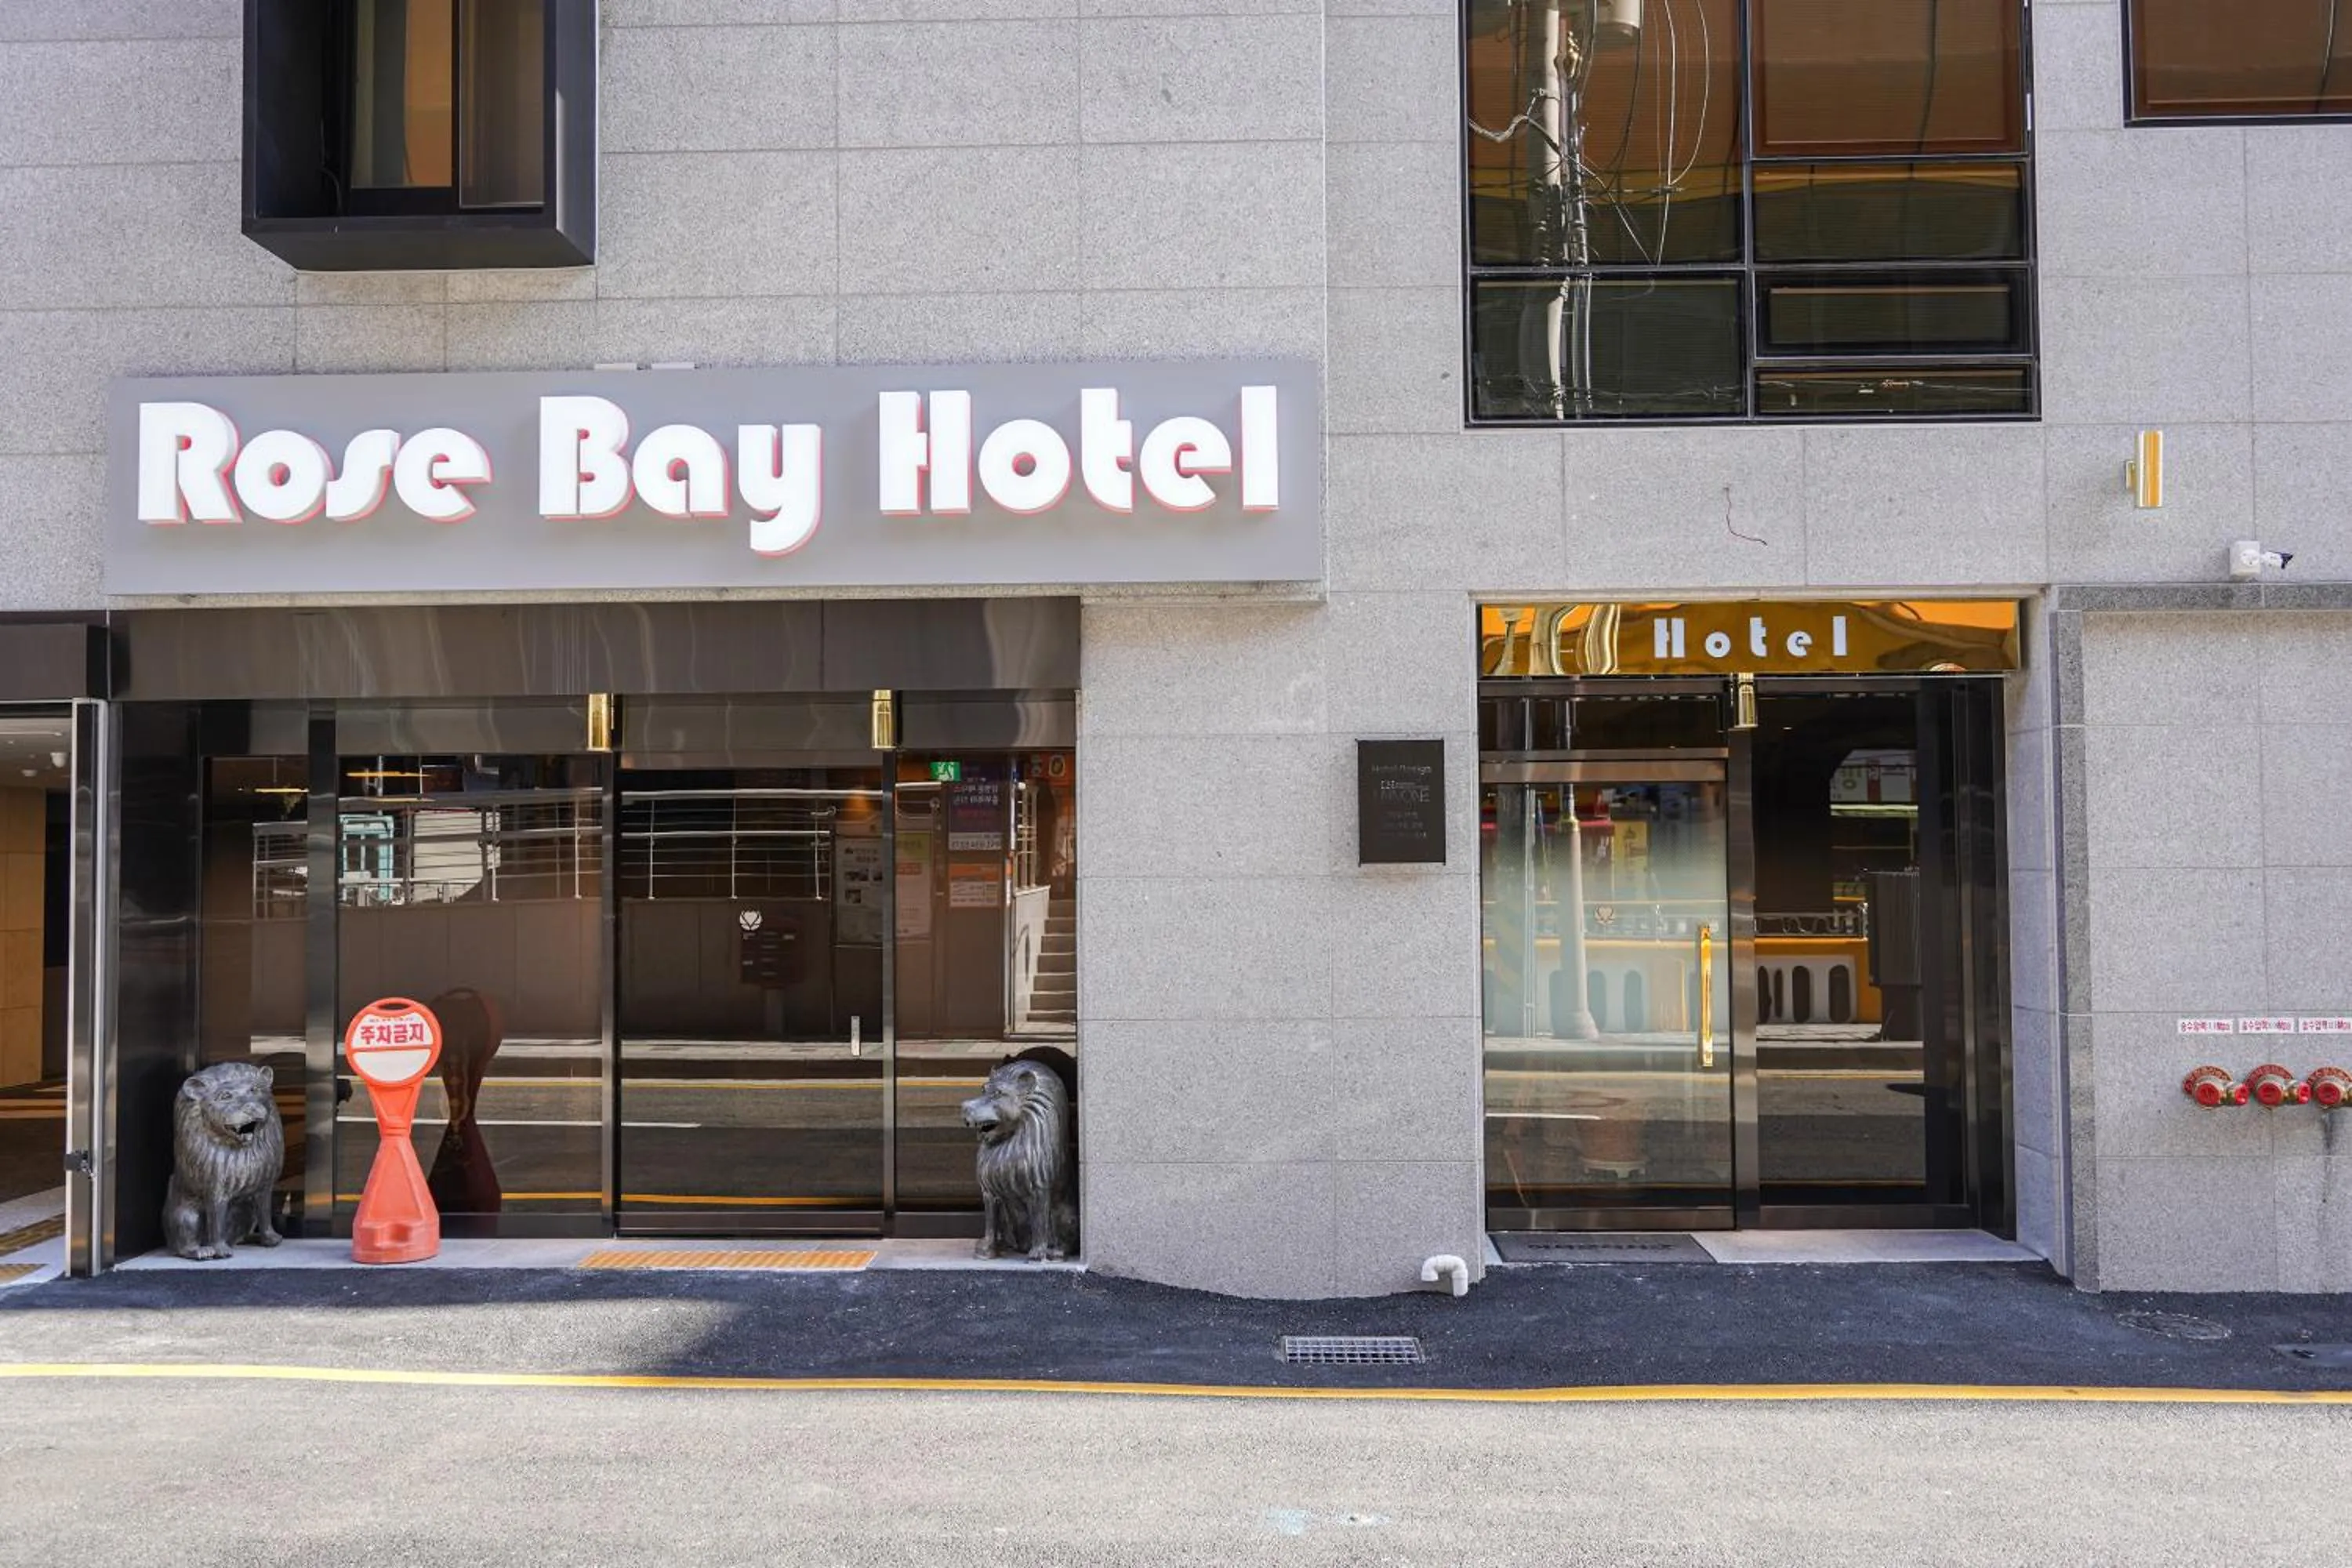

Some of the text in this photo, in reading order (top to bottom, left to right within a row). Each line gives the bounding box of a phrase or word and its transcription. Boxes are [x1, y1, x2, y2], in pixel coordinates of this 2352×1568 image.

[137, 385, 1279, 556] Rose Bay Hotel
[1653, 615, 1848, 659] Hotel
[361, 1023, 423, 1044] 주차금지
